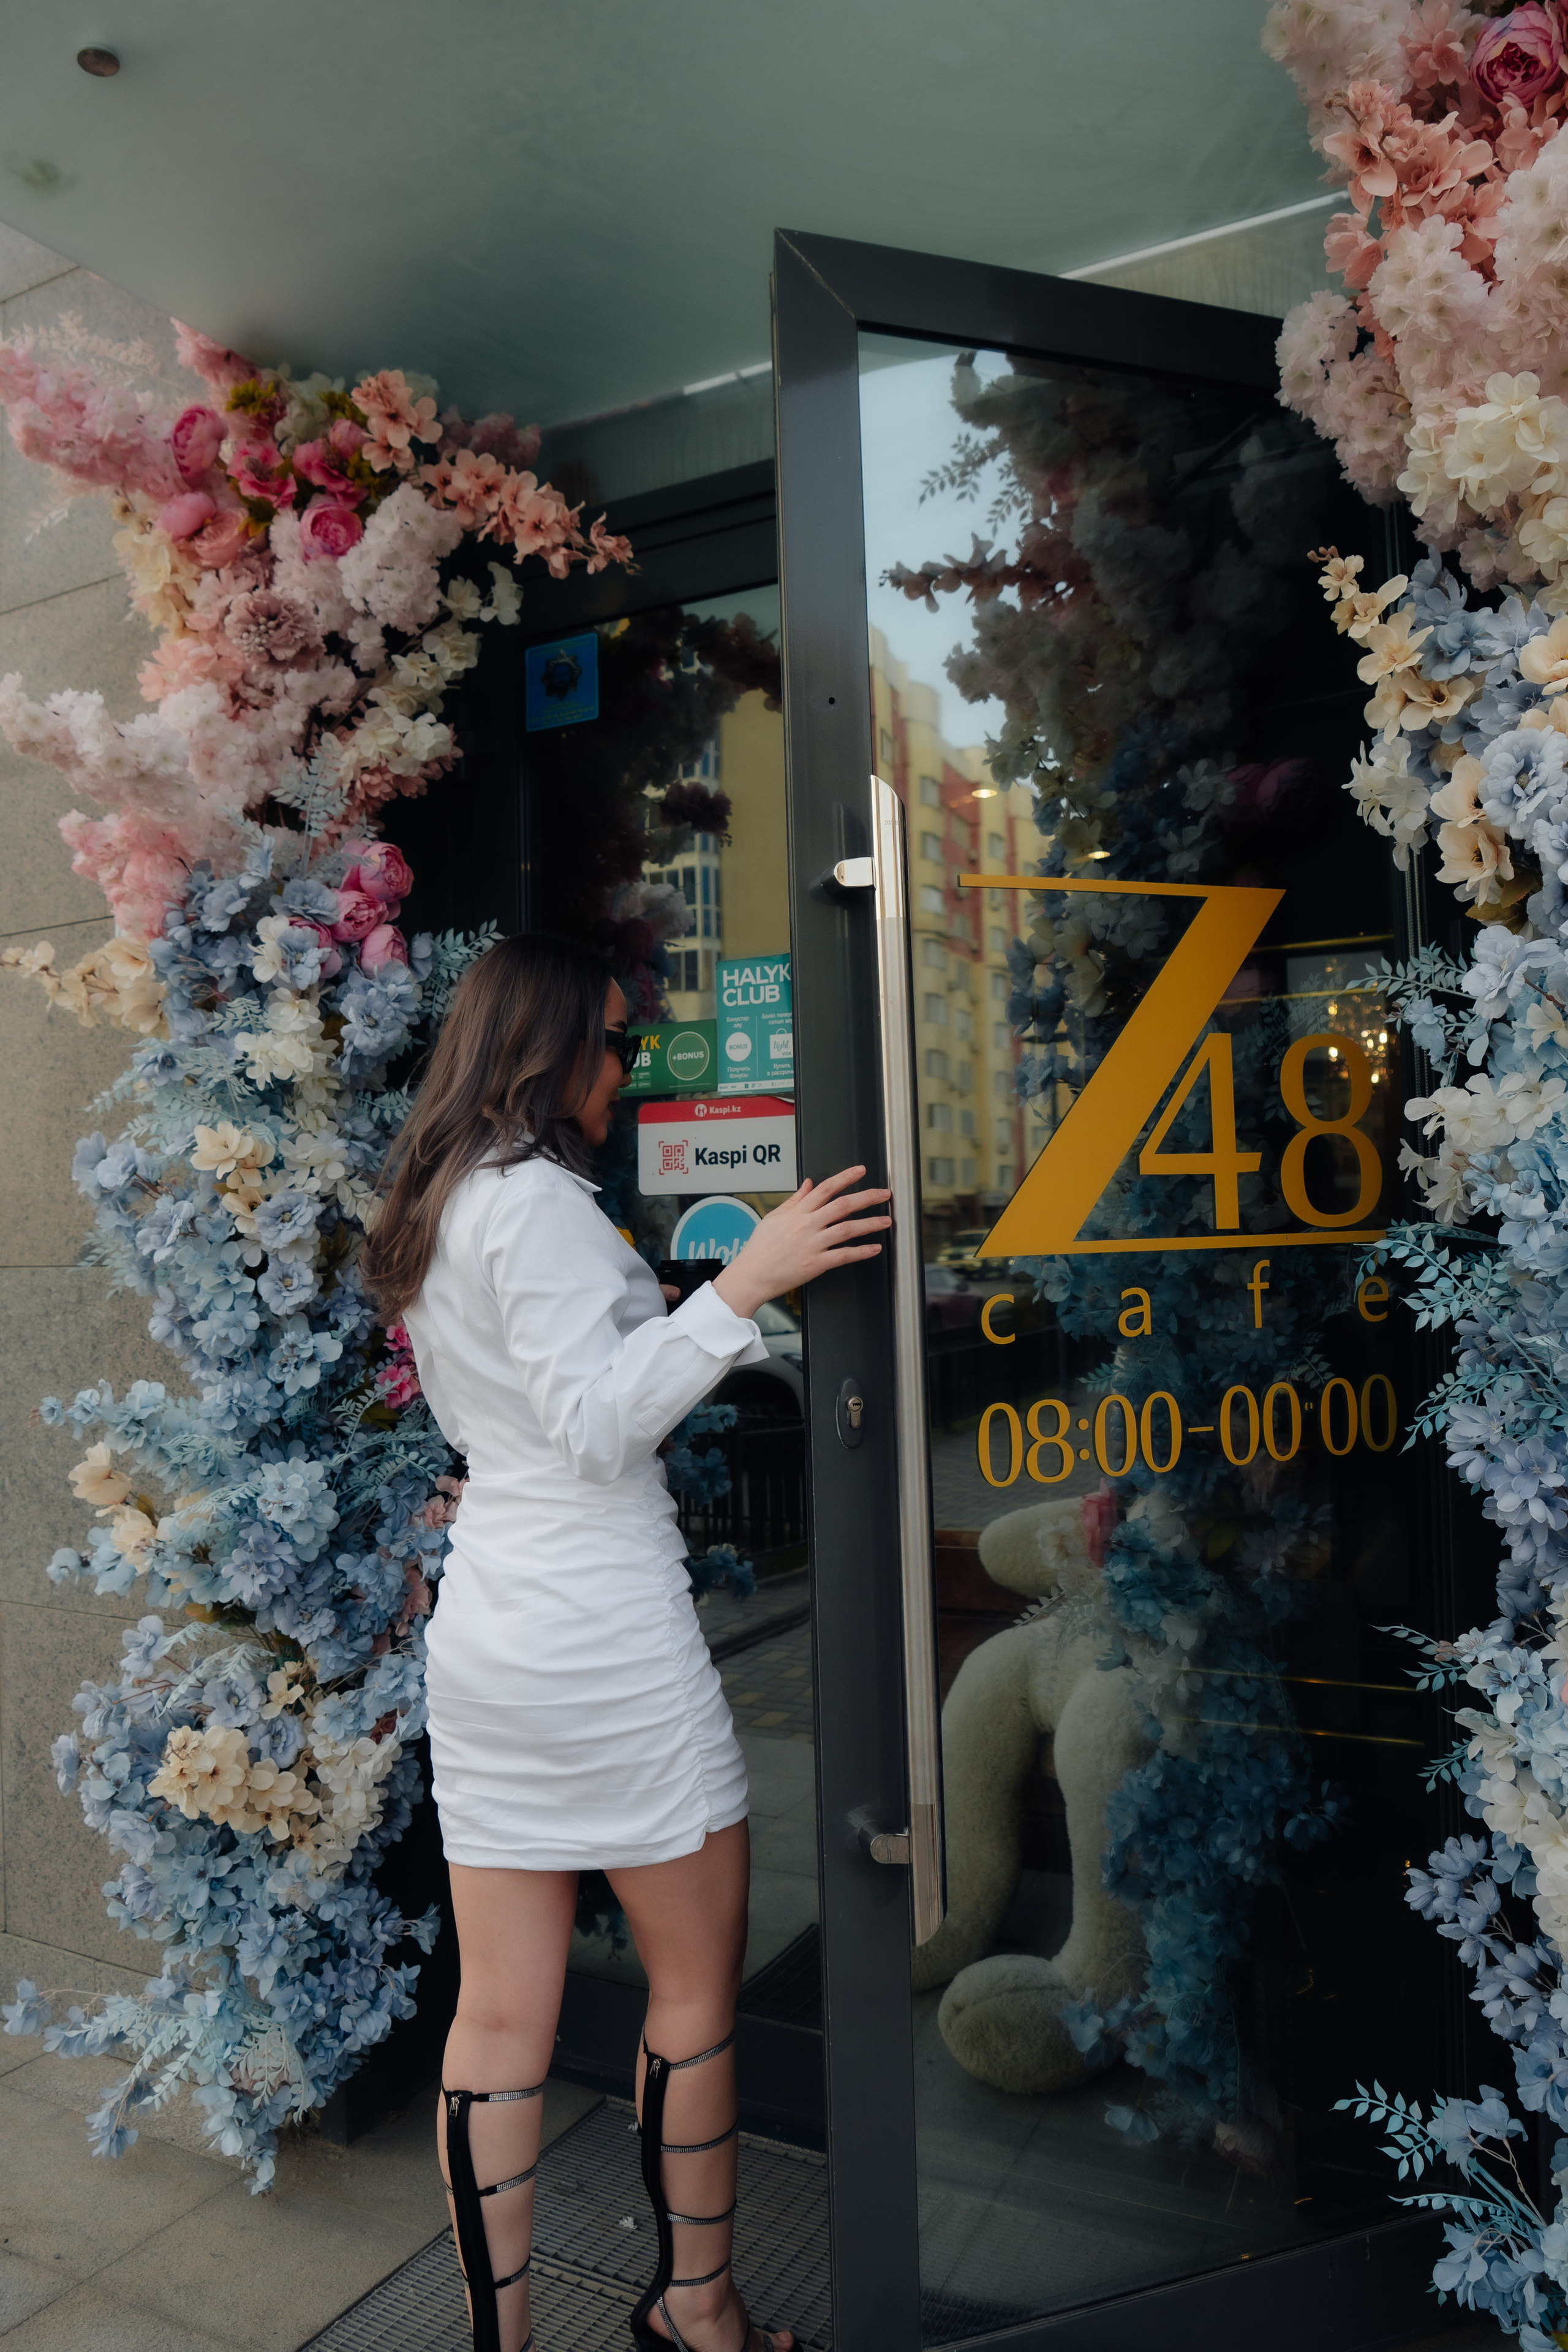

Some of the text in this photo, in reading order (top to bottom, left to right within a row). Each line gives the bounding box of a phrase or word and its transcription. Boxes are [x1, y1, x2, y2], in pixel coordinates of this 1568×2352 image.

[723, 962, 791, 987] HALYK
[723, 984, 780, 1007] CLUB
[672, 1051, 704, 1061] +BONUS
[709, 1104, 741, 1115] Kaspi.kz
[695, 1144, 781, 1169] Kaspi QR
